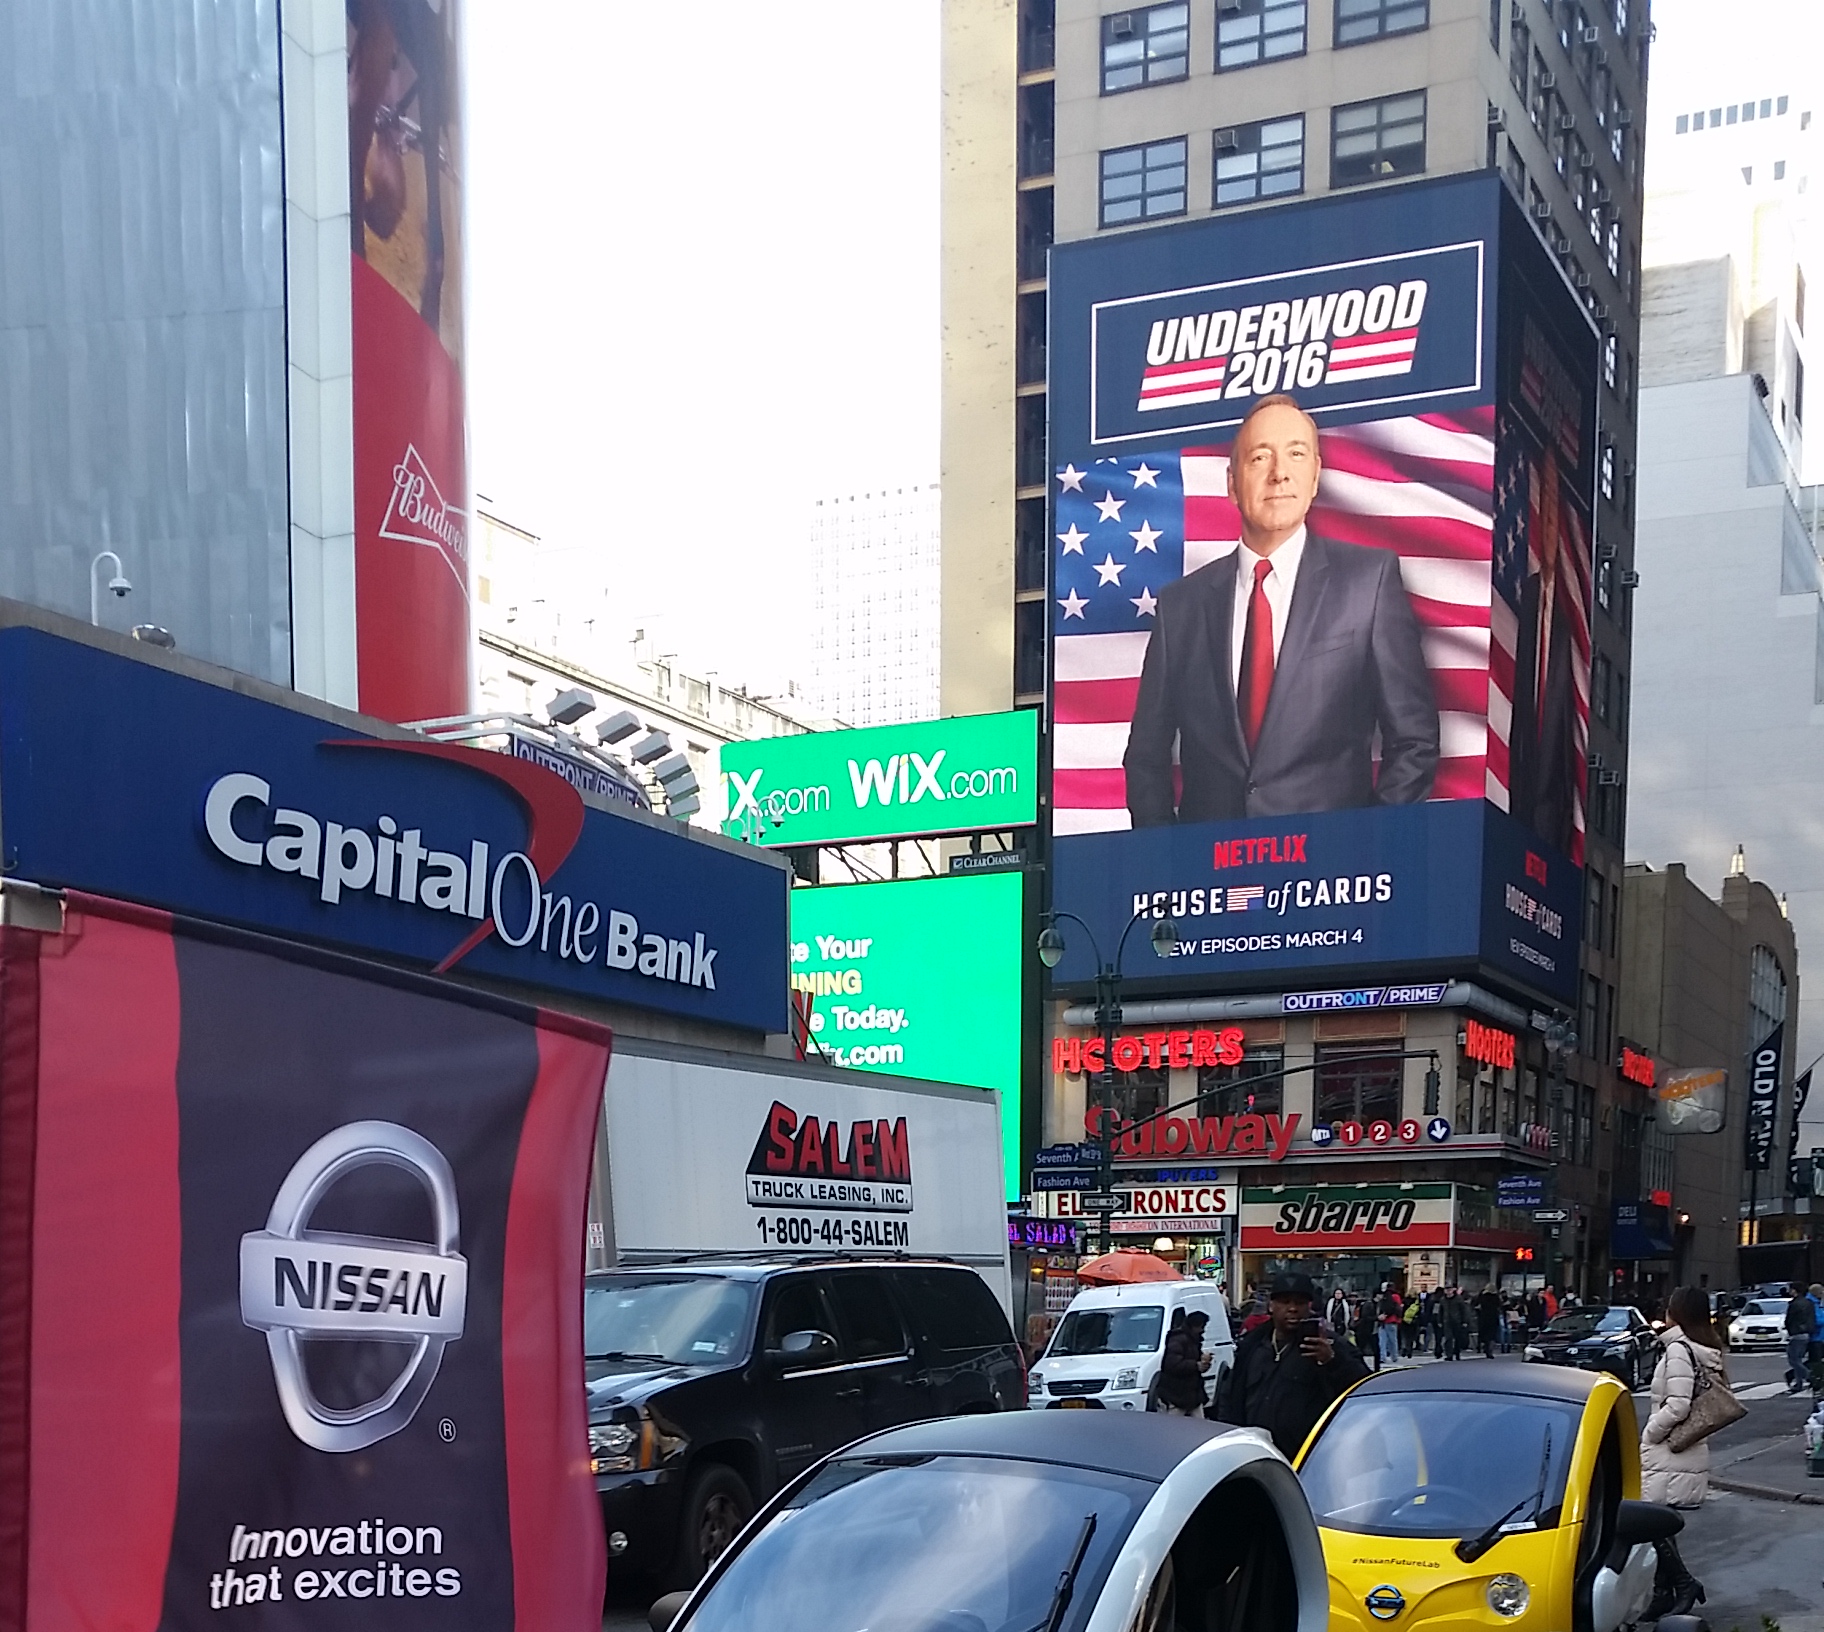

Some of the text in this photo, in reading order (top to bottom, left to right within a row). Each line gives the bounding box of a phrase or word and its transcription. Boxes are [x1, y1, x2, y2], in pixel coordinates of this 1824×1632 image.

[1146, 279, 1428, 366] UNDERWOOD
[1224, 342, 1328, 399] 2016
[1213, 834, 1307, 870] NETFLIX
[204, 772, 490, 920] Capital
[606, 909, 718, 991] Bank
[1133, 873, 1393, 920] HOUSE of CARDS
[815, 934, 873, 961] Your
[1157, 928, 1364, 958] EW EPISODES MARCH 4
[830, 1003, 910, 1034] Today.
[1285, 986, 1440, 1010] OUTFRONT PRIME
[1052, 1027, 1245, 1074] HOOTERS
[1465, 1019, 1515, 1070] HOOTERS
[1753, 1049, 1776, 1095] OLD
[765, 1101, 912, 1183] SALEM
[1084, 1105, 1302, 1162] Subway
[1345, 1125, 1354, 1141] 1
[1373, 1124, 1386, 1141] 2
[1402, 1123, 1415, 1140] 3
[1036, 1152, 1072, 1164] Seventh
[752, 1180, 909, 1206] TRUCK LEASING, INC.
[1037, 1176, 1090, 1188] Fashion Ave
[1057, 1188, 1227, 1216] ELRONICS
[756, 1216, 910, 1247] 1-800-44-SALEM
[1274, 1192, 1417, 1234] sbarro
[274, 1256, 447, 1319] NISSAN
[229, 1517, 443, 1562] Innovation
[1352, 1557, 1441, 1568] #NissanFutureLab
[208, 1560, 463, 1610] that excites
